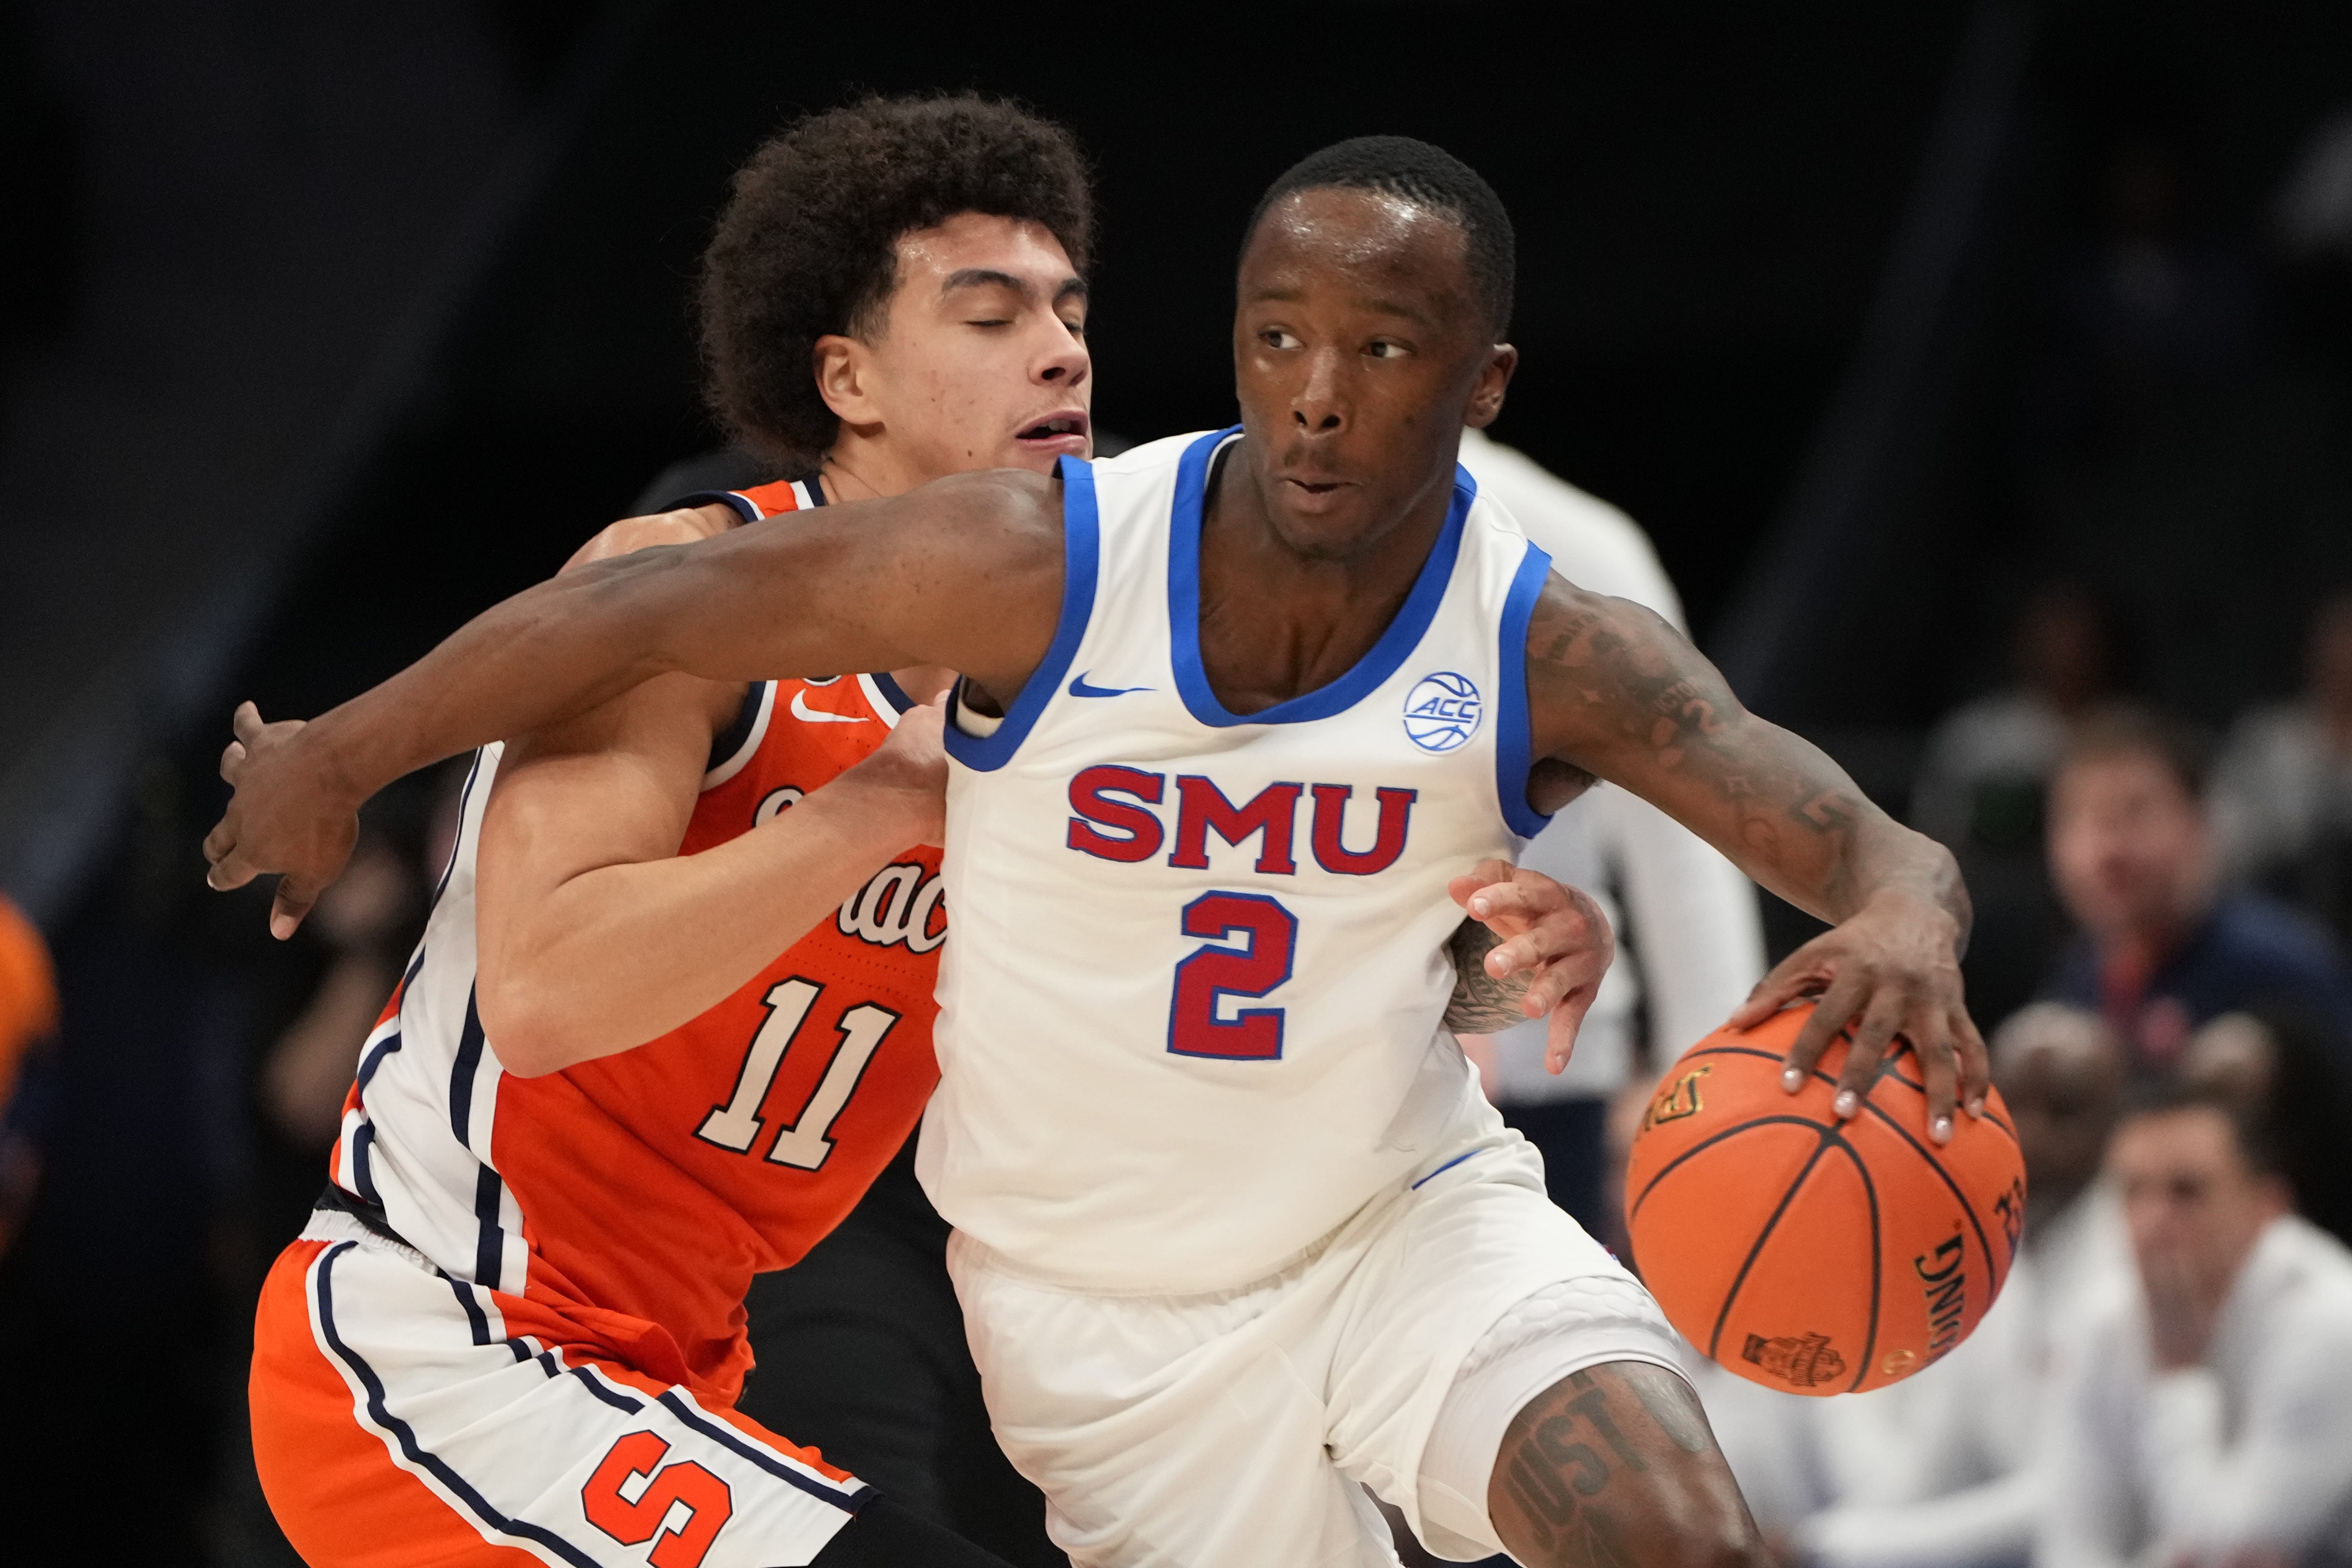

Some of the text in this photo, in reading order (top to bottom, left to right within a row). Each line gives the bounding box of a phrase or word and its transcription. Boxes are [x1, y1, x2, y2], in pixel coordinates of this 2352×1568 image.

[1411, 697, 1482, 719] ACC
[1067, 765, 1418, 876] SMU
[1167, 890, 1298, 1060] 2
[692, 974, 903, 1171] 11
[1913, 1234, 1964, 1362] DING
[581, 1429, 733, 1568] S
[1503, 1387, 1651, 1553] JUST
